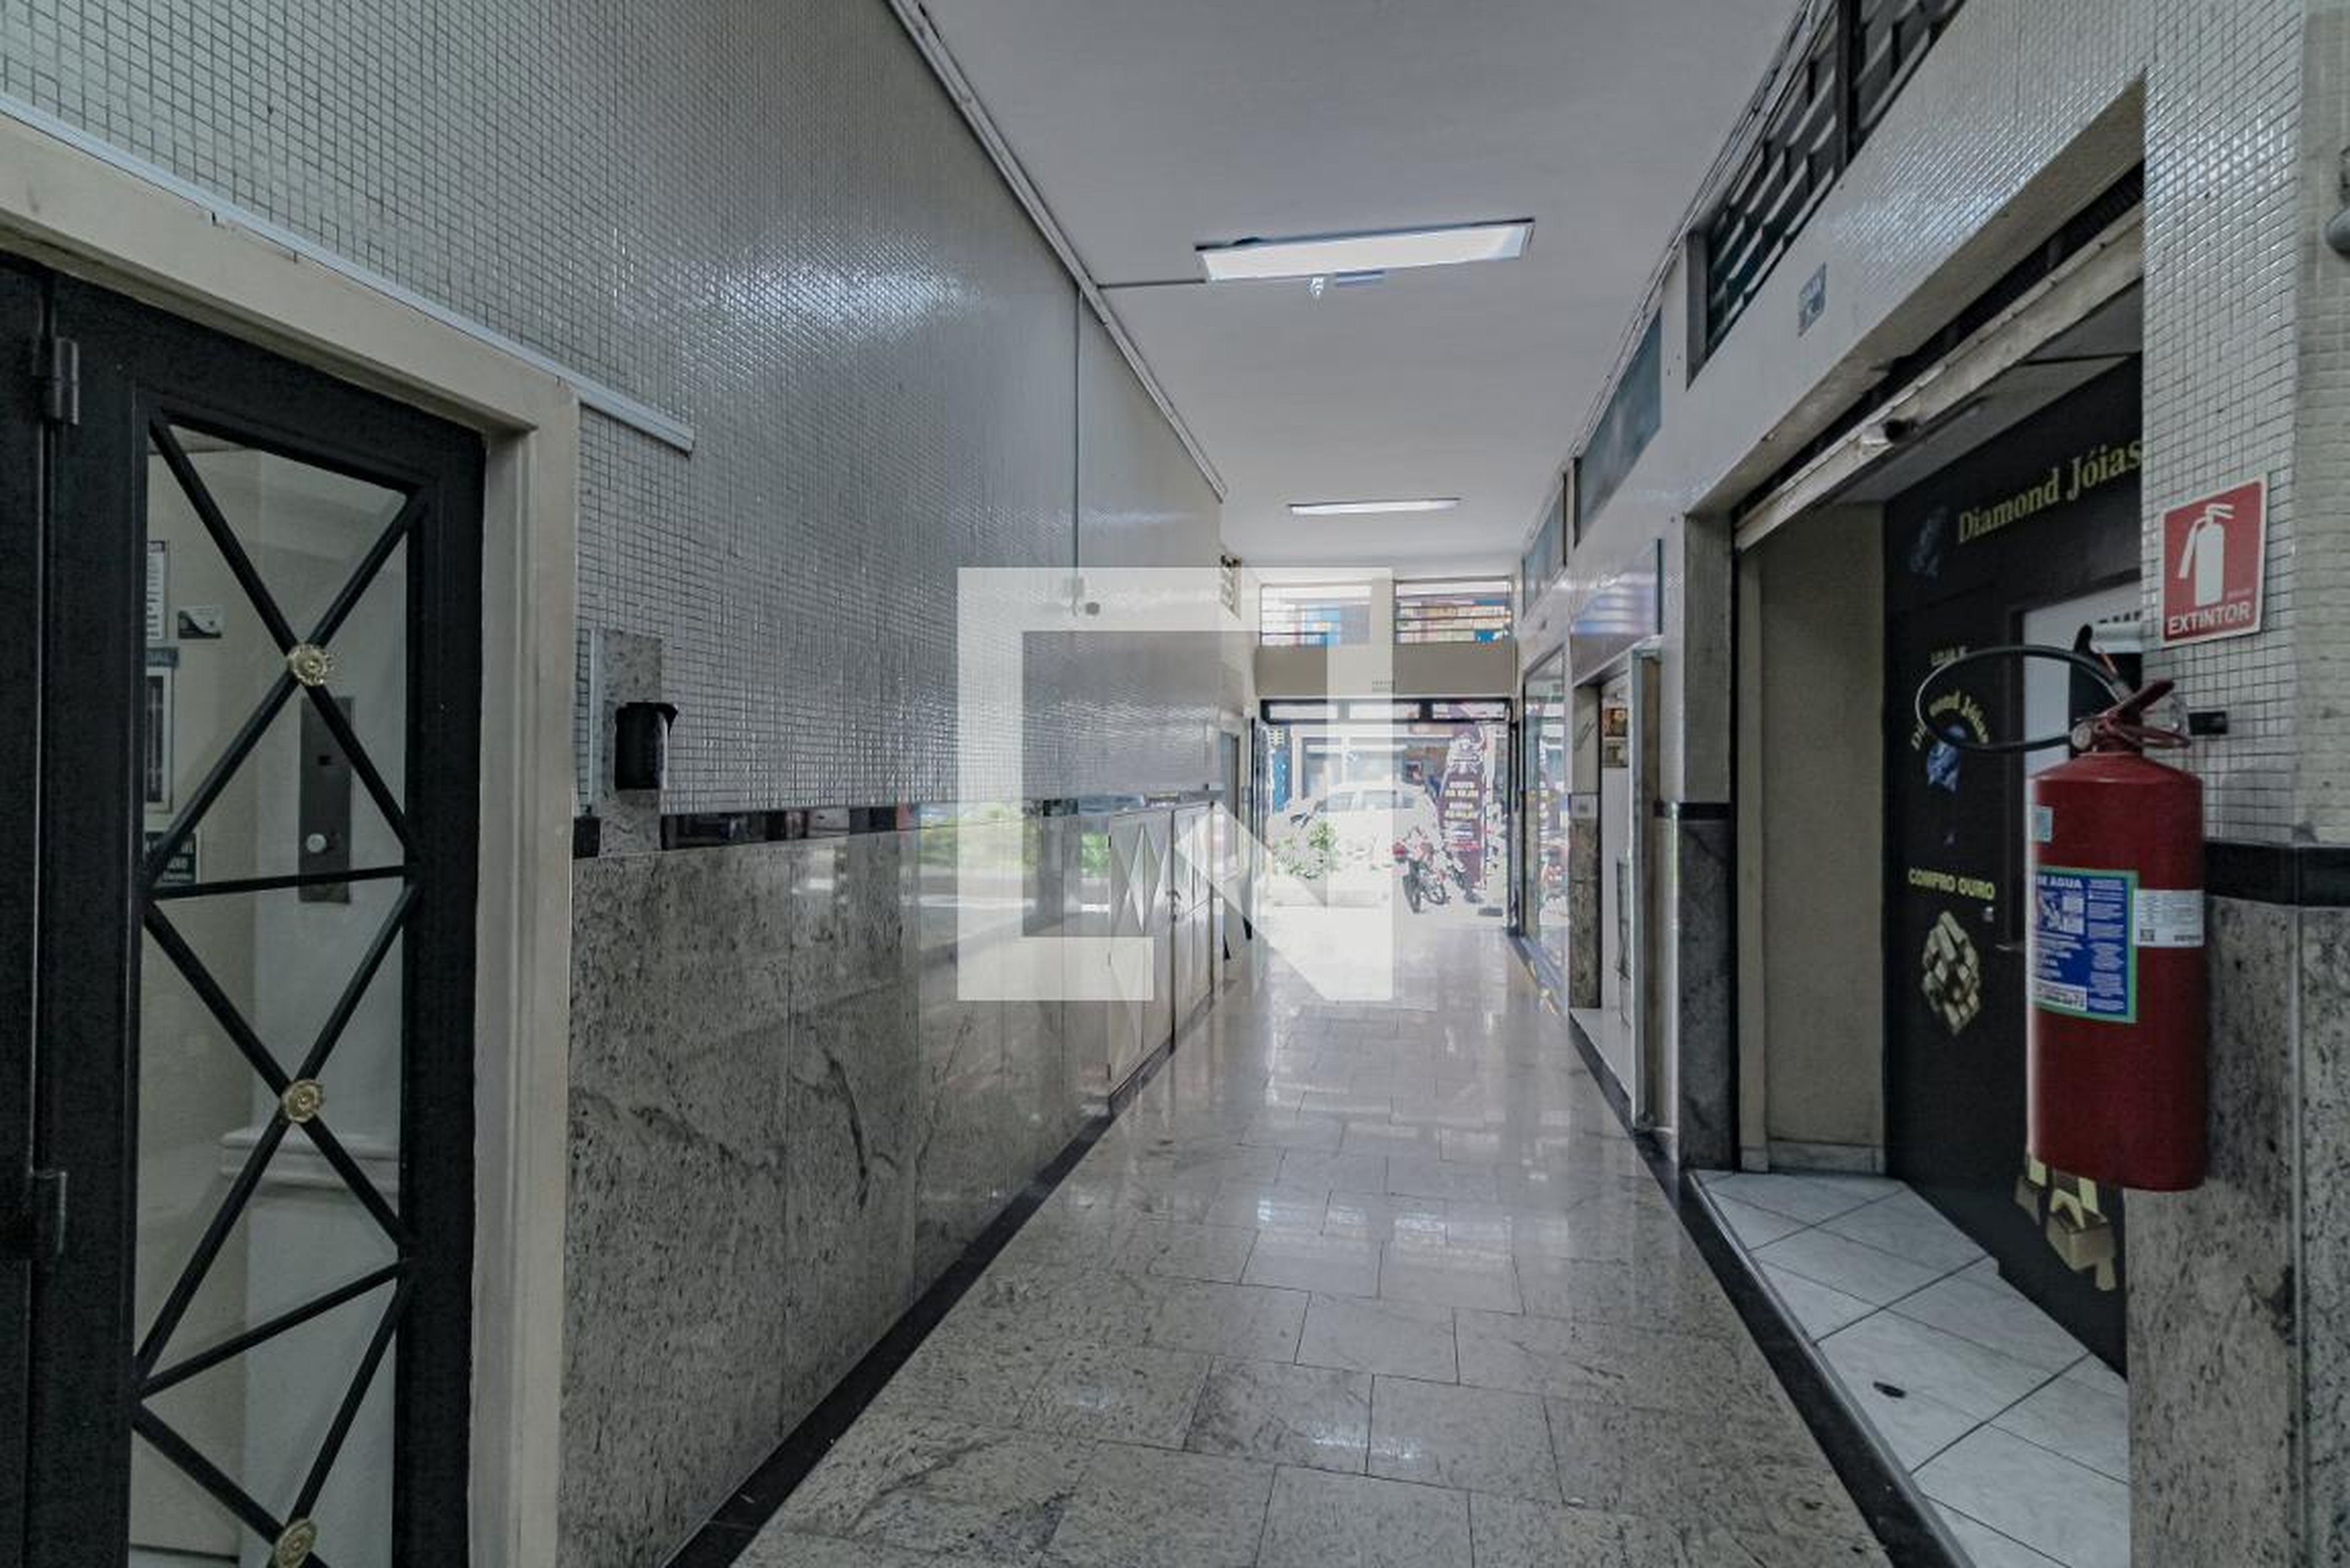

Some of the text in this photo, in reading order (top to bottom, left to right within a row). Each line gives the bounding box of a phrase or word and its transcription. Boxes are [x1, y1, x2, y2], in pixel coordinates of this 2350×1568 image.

[1959, 440, 2142, 543] Diamond Jóias
[2168, 600, 2250, 636] EXTINTOR
[1908, 868, 1995, 900] COMPRO OURO
